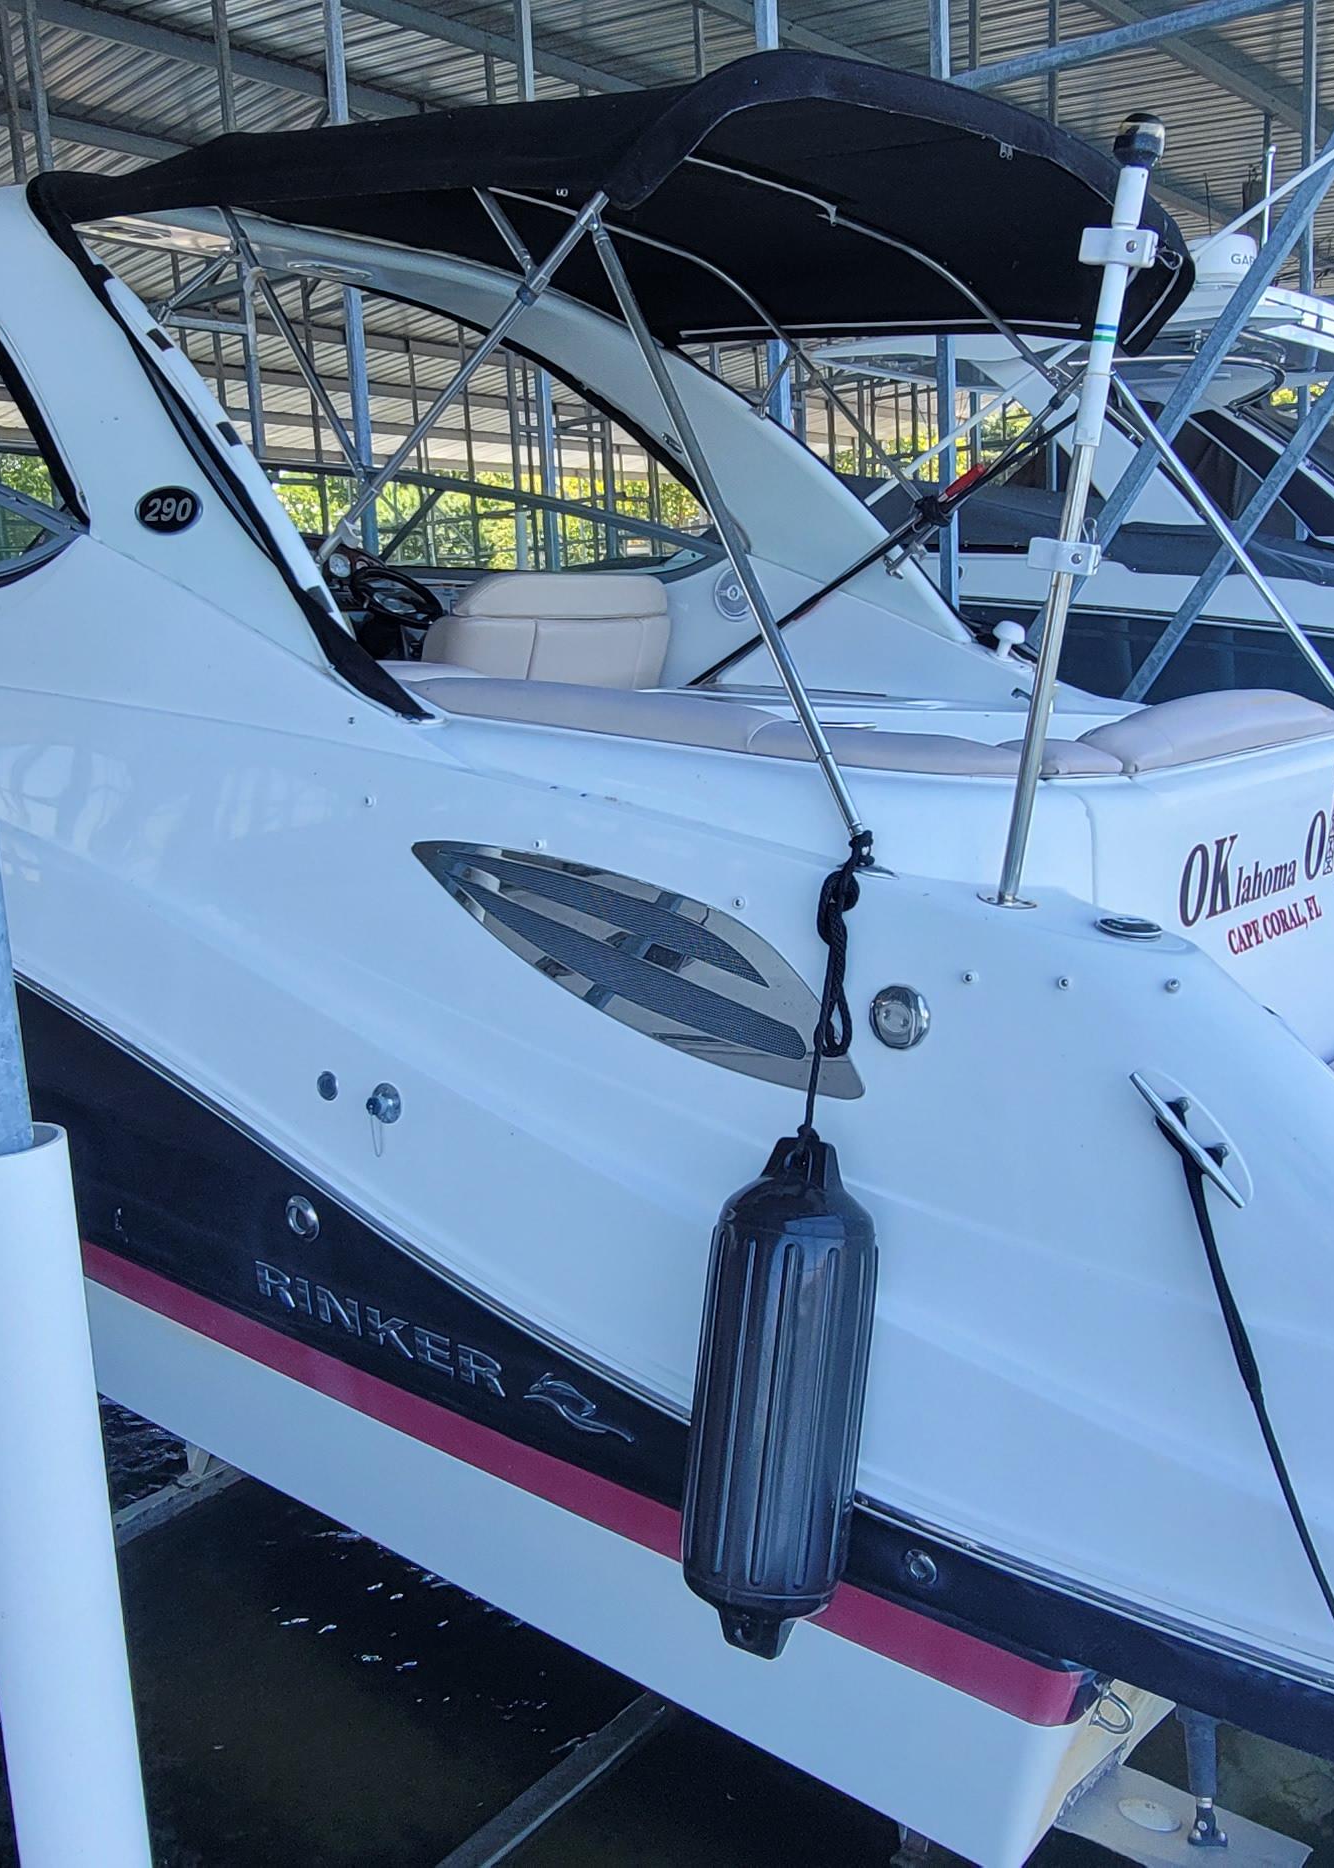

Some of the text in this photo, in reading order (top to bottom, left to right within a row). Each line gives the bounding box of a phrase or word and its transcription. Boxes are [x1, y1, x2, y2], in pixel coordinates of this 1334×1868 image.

[144, 497, 193, 522] 290
[1179, 833, 1297, 928] OKlahoma
[1228, 895, 1322, 955] CAPE CORAL, FL
[255, 1260, 506, 1398] RINKER
